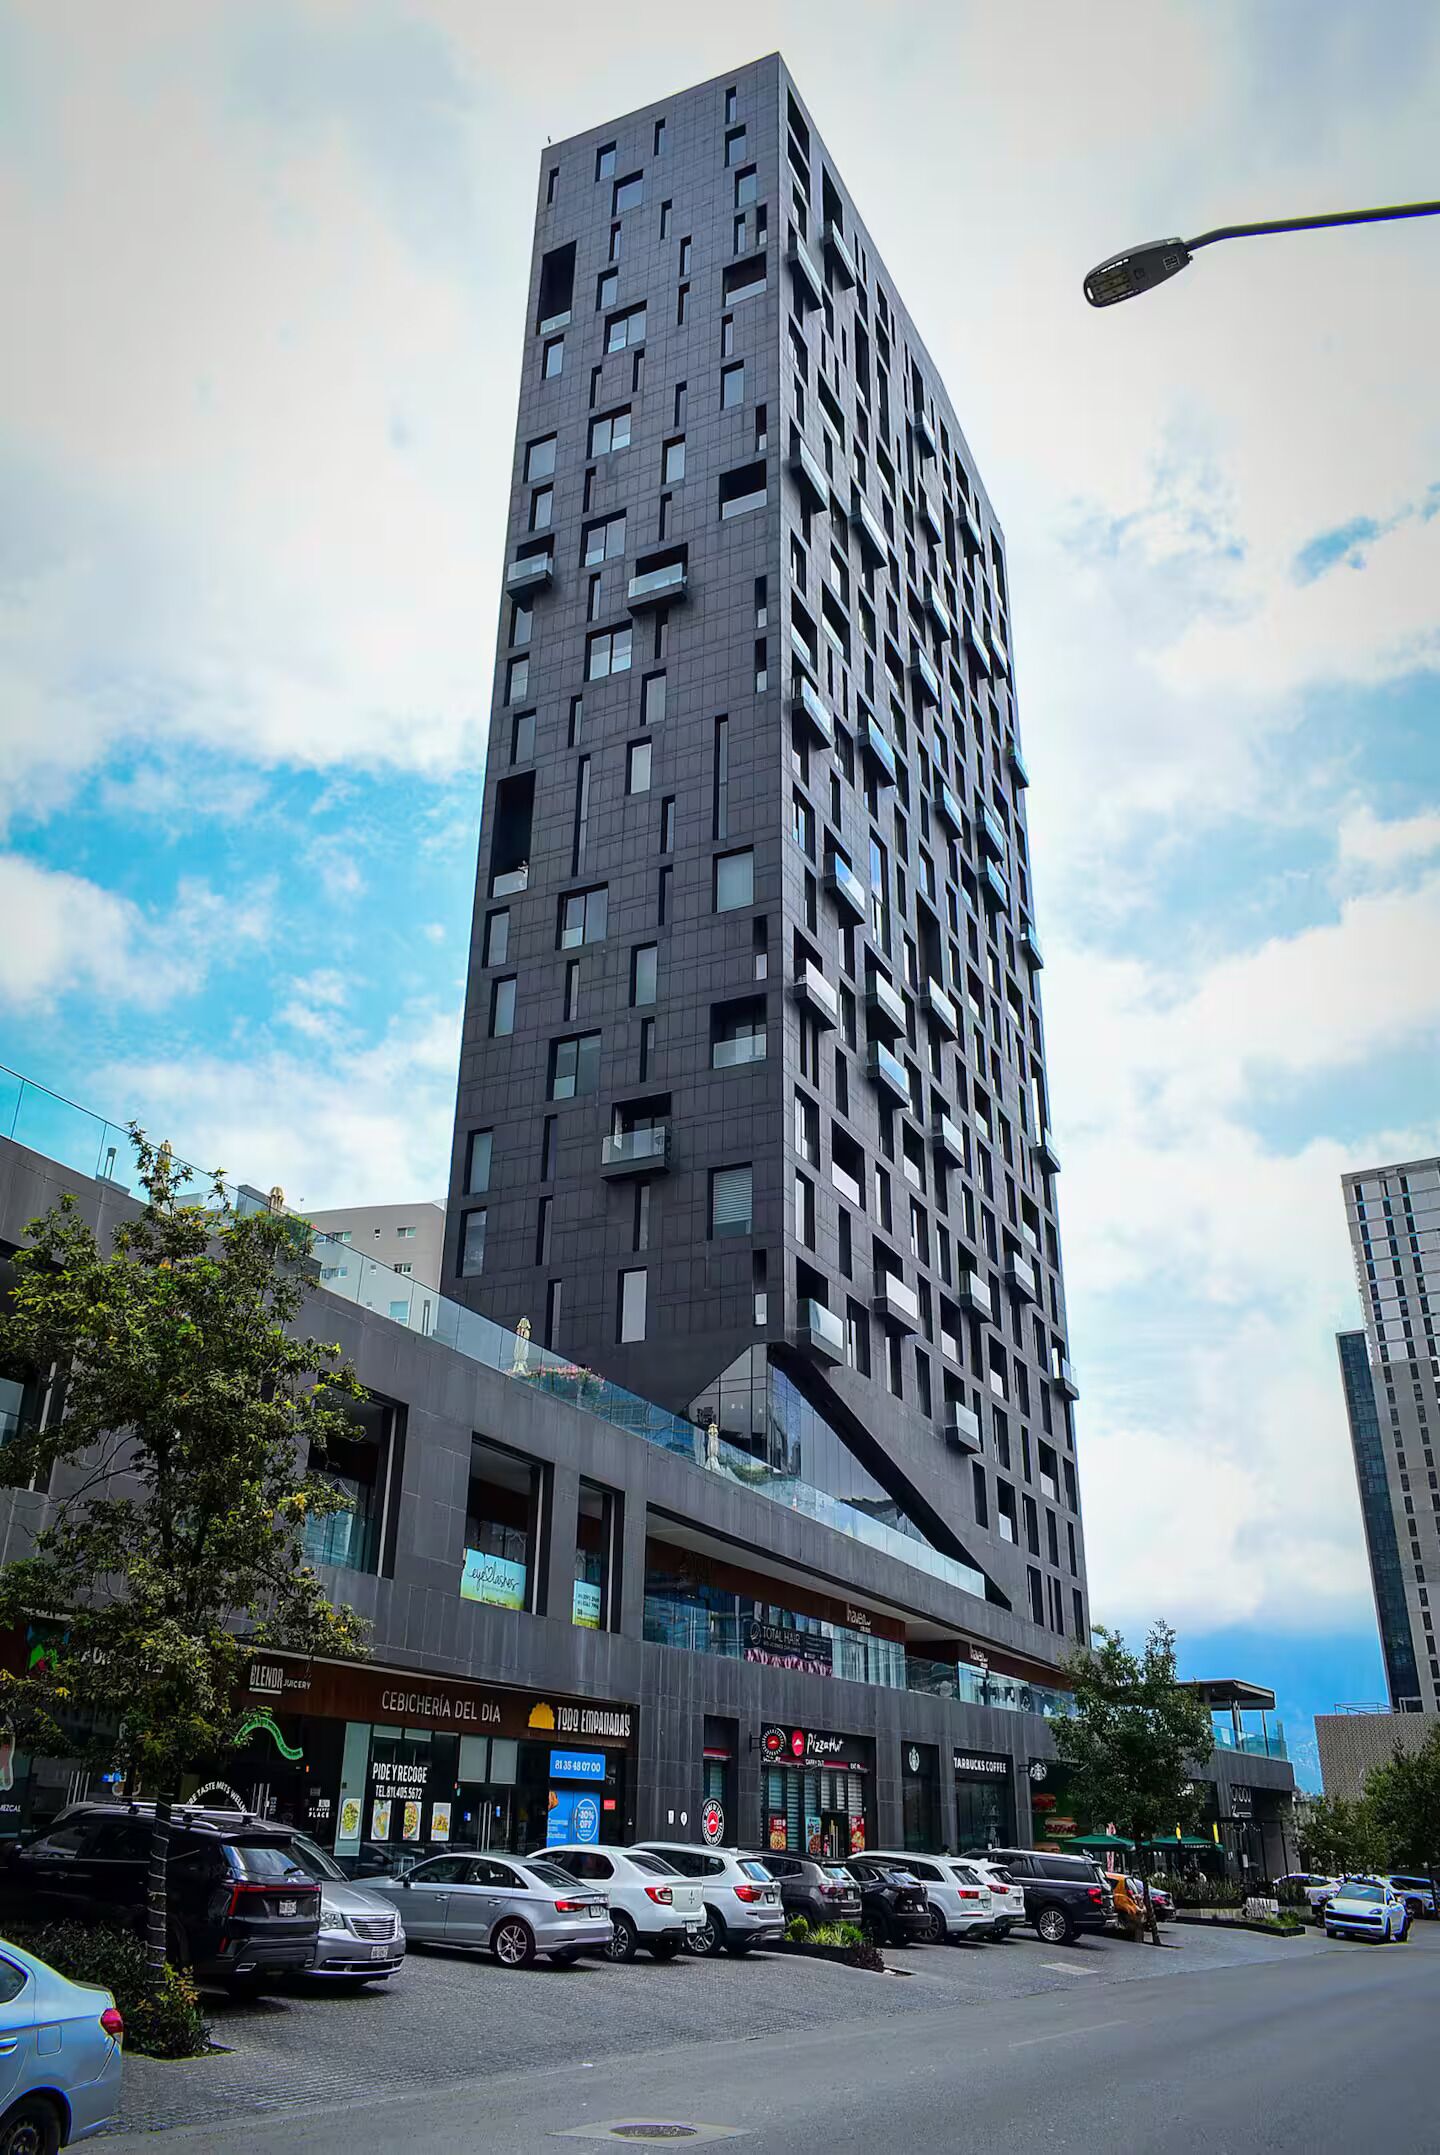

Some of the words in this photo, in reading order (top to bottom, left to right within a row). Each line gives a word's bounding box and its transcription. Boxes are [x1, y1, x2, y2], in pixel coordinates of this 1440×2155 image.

[762, 1626, 783, 1643] TOTAL
[784, 1631, 801, 1645] HAIR
[250, 1664, 283, 1688] BLENDR
[283, 1679, 311, 1689] JUICERY
[382, 1691, 450, 1717] CEBICHERÍA
[455, 1701, 477, 1720] DEL
[558, 1706, 579, 1732] TODO
[581, 1709, 631, 1737] EMPANADAS
[372, 1762, 391, 1781] PIDE
[392, 1764, 398, 1781] Y
[397, 1764, 428, 1783] RECOGE
[555, 1760, 563, 1770] 81
[563, 1760, 572, 1771] 35
[581, 1762, 590, 1772] 07
[591, 1762, 600, 1772] 00
[953, 1757, 985, 1771] TARBUCKS
[985, 1761, 1006, 1773] COFFEE
[197, 1781, 215, 1797] TASTE
